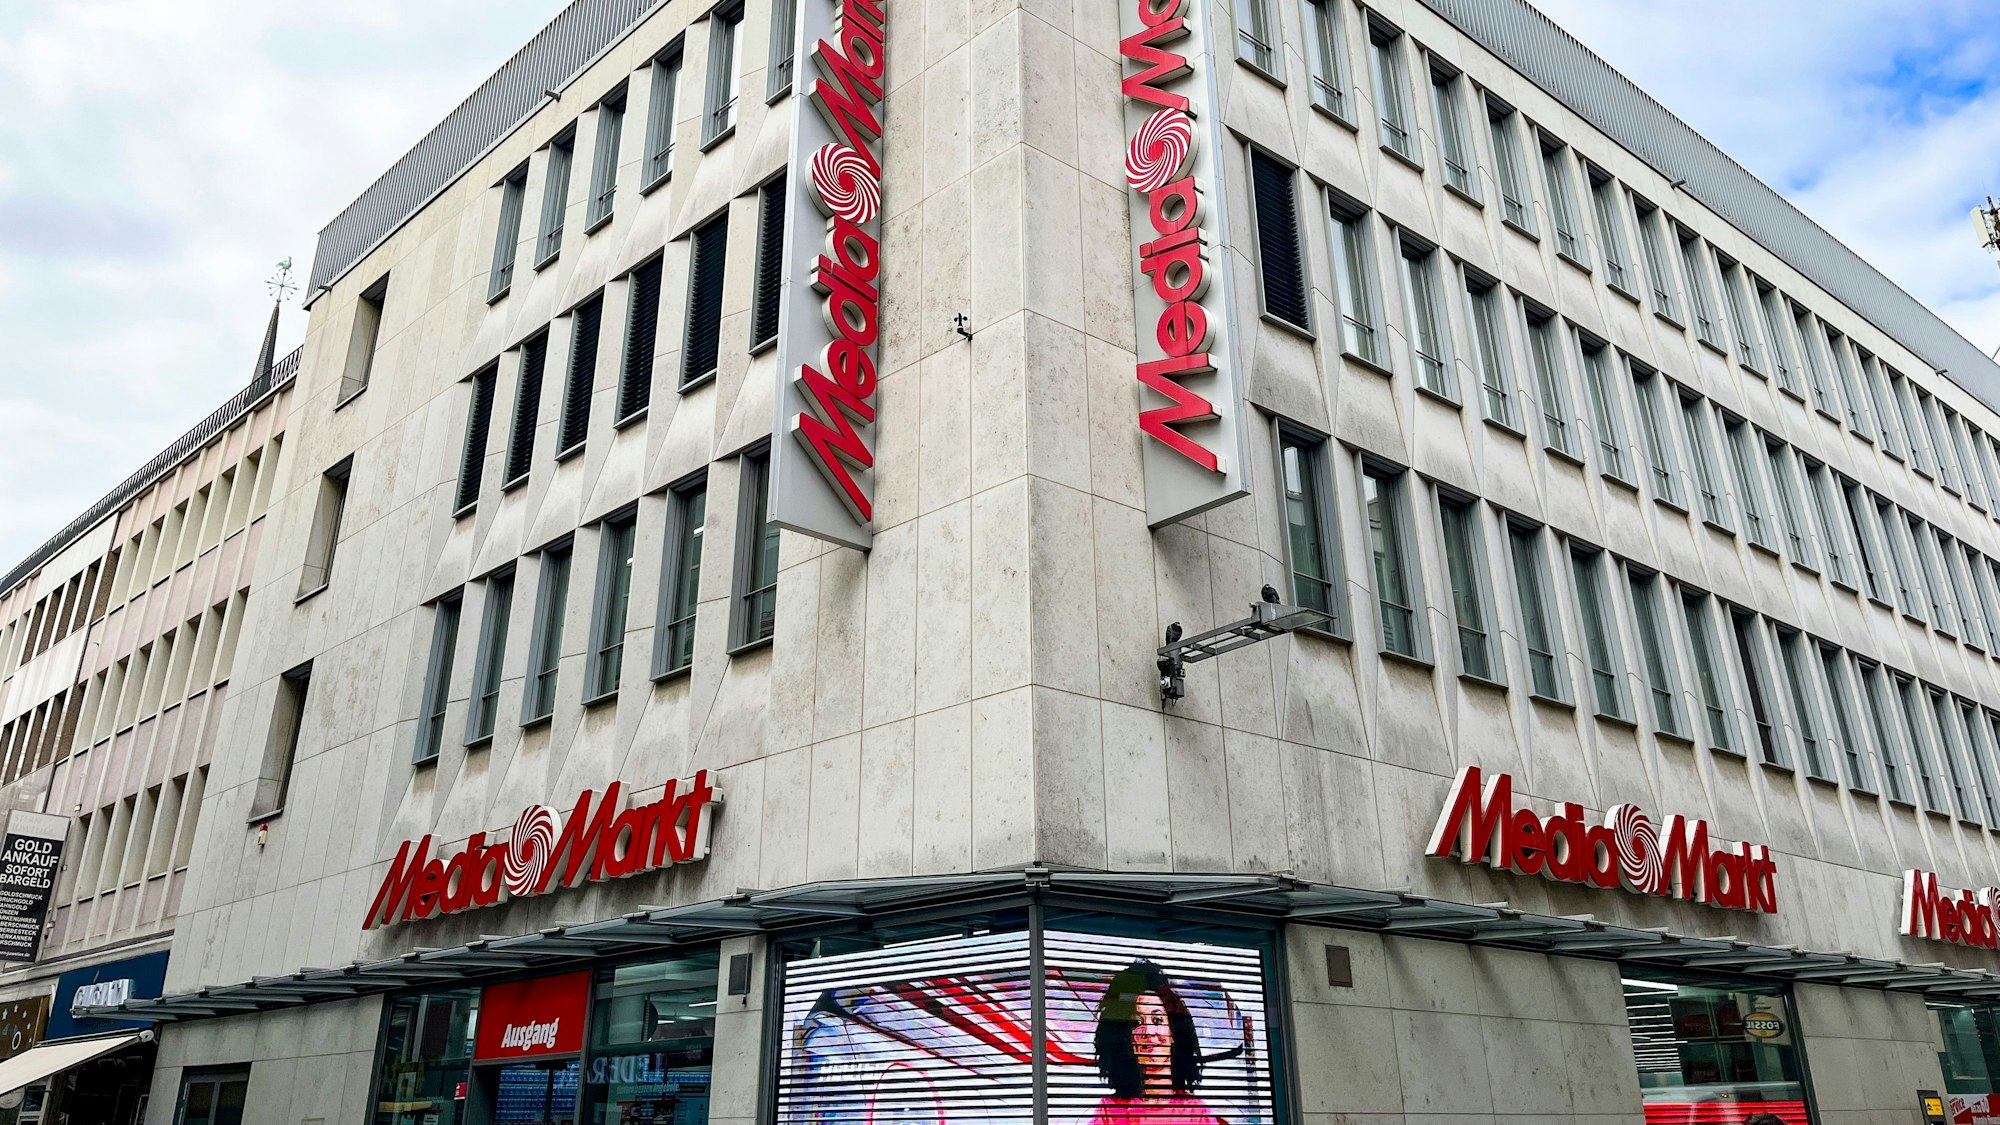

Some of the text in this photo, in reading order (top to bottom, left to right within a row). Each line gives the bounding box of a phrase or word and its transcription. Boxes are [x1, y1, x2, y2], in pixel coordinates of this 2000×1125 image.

[1137, 176, 1226, 475] Media
[794, 215, 881, 525] Media
[15, 838, 53, 854] GOLD
[362, 769, 723, 931] Media Markt
[1427, 766, 1777, 914] Media Markt
[2, 850, 59, 867] ANKAUF
[5, 864, 50, 878] SOFORT
[0, 873, 51, 889] BARGELD
[0, 890, 43, 900] GOLDSCHMUCK
[1901, 869, 1998, 949] Media
[501, 1017, 560, 1052] Ausgang
